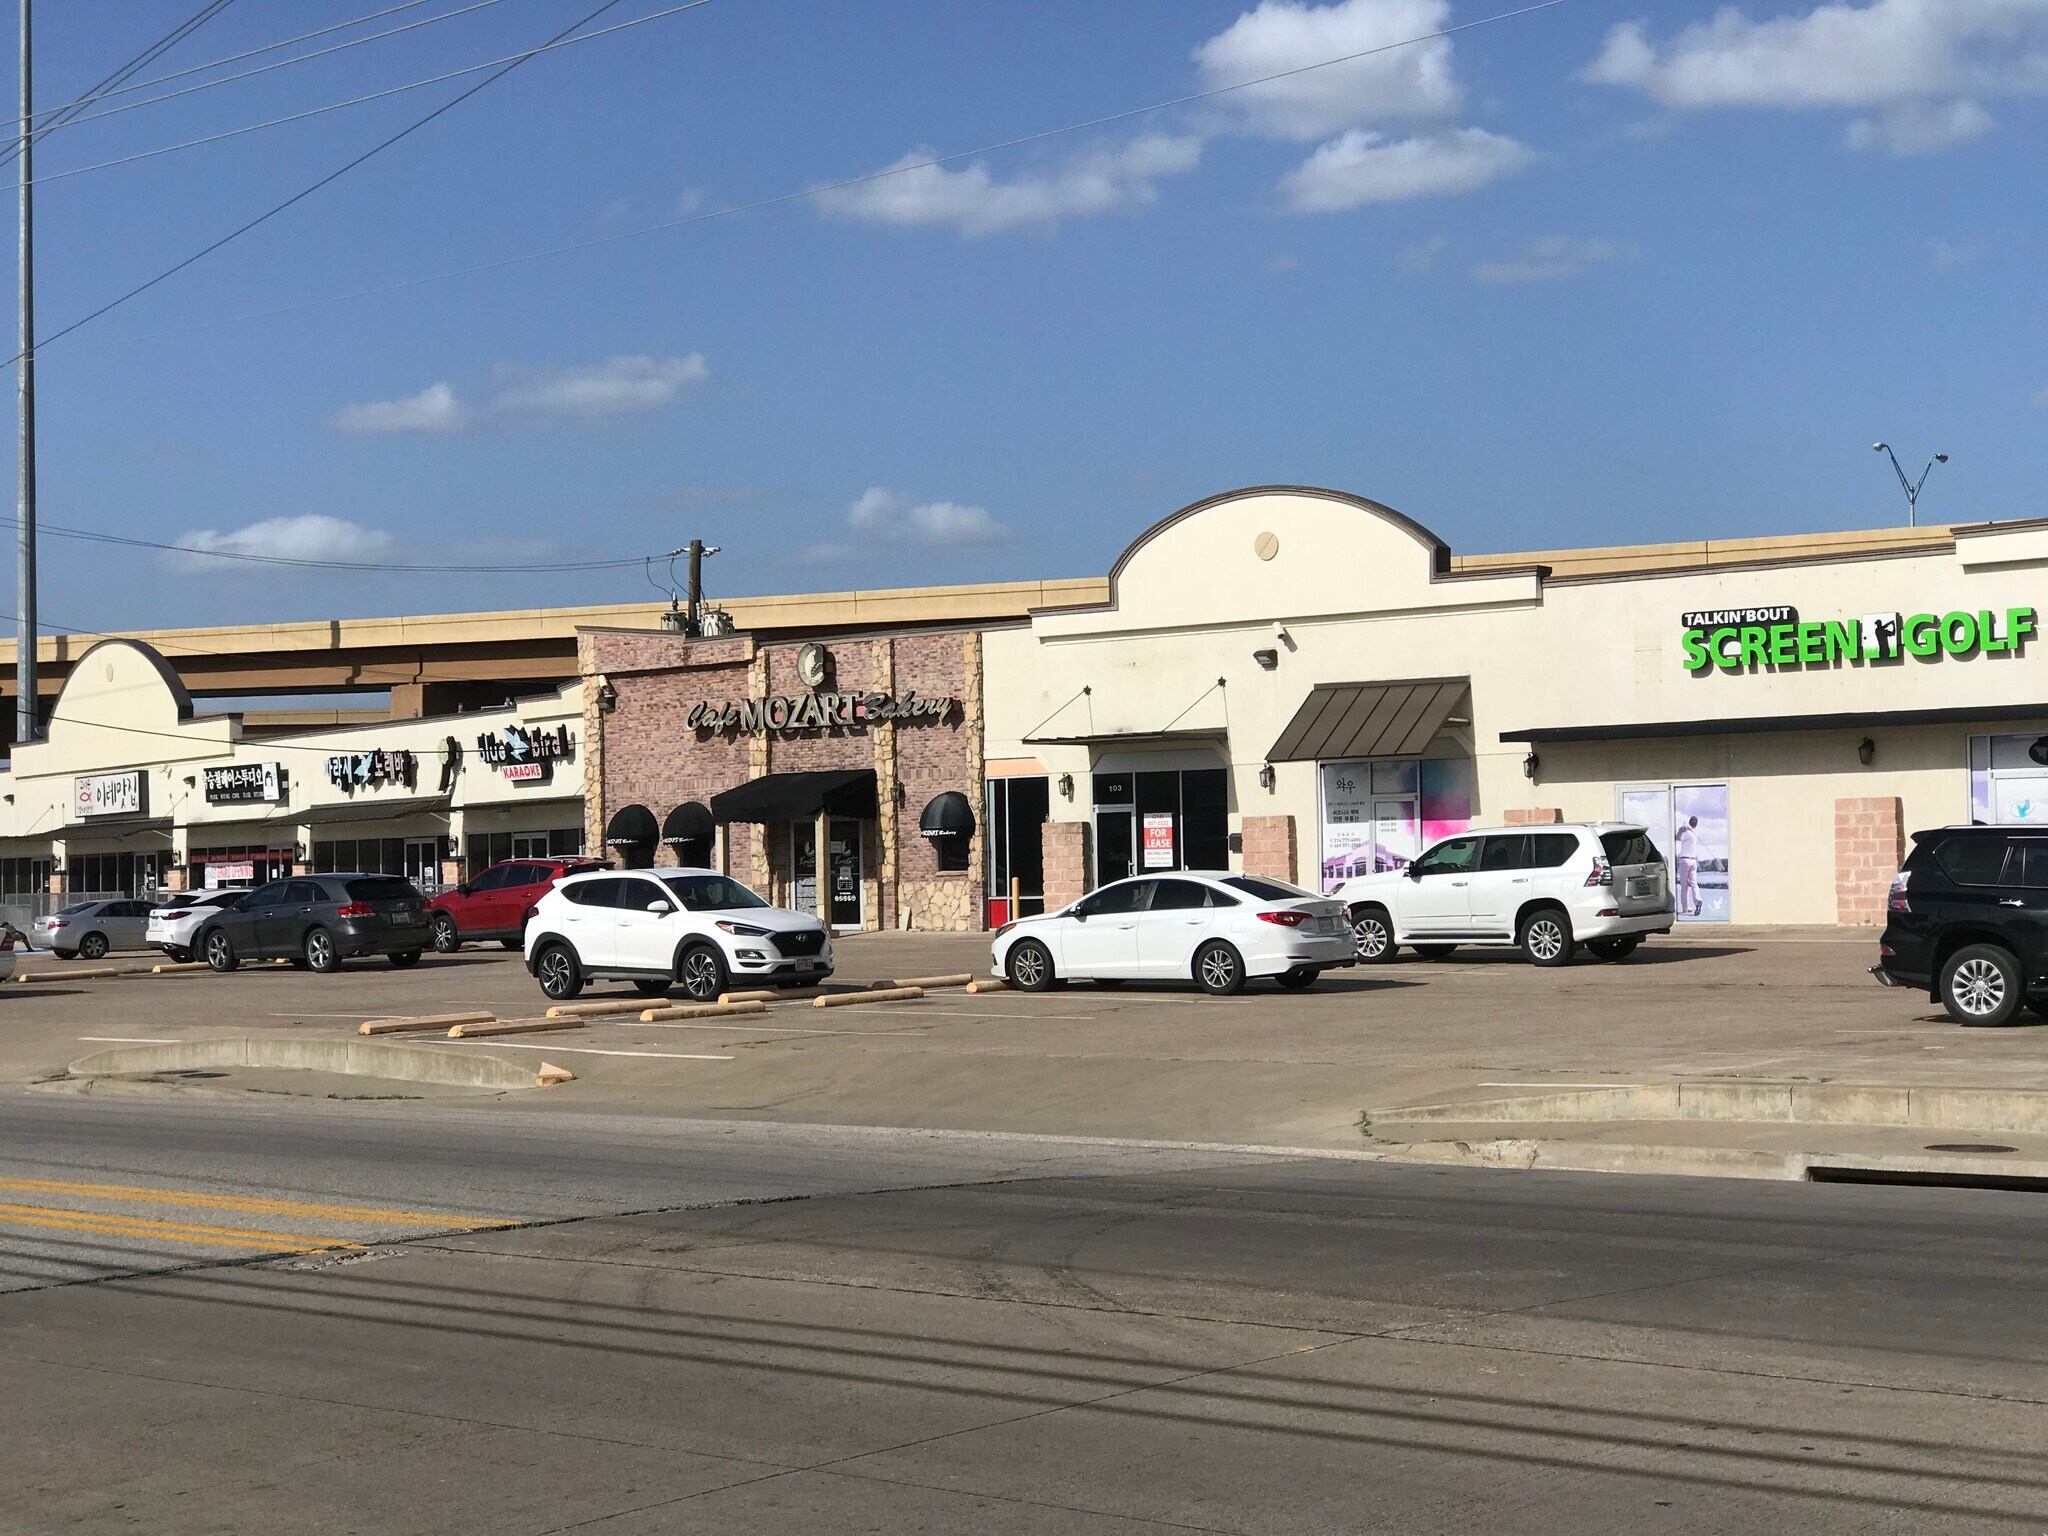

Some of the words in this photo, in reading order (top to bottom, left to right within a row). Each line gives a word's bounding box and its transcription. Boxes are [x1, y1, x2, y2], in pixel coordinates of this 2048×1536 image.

[1685, 607, 1790, 626] TALKIN'BOUT
[1682, 619, 1859, 670] SCREEN
[1903, 607, 2032, 655] GOLF
[684, 700, 738, 734] Cafe
[740, 691, 863, 731] MOZART
[861, 691, 952, 722] Bakery
[530, 727, 562, 758] bird
[374, 752, 405, 785] 노래방
[502, 764, 541, 780] KARAOKE
[96, 775, 137, 809] 이레맛집
[1108, 784, 1123, 792] 103
[1335, 777, 1356, 794] 와우
[1150, 828, 1167, 838] FOR
[1146, 839, 1171, 848] LEASE
